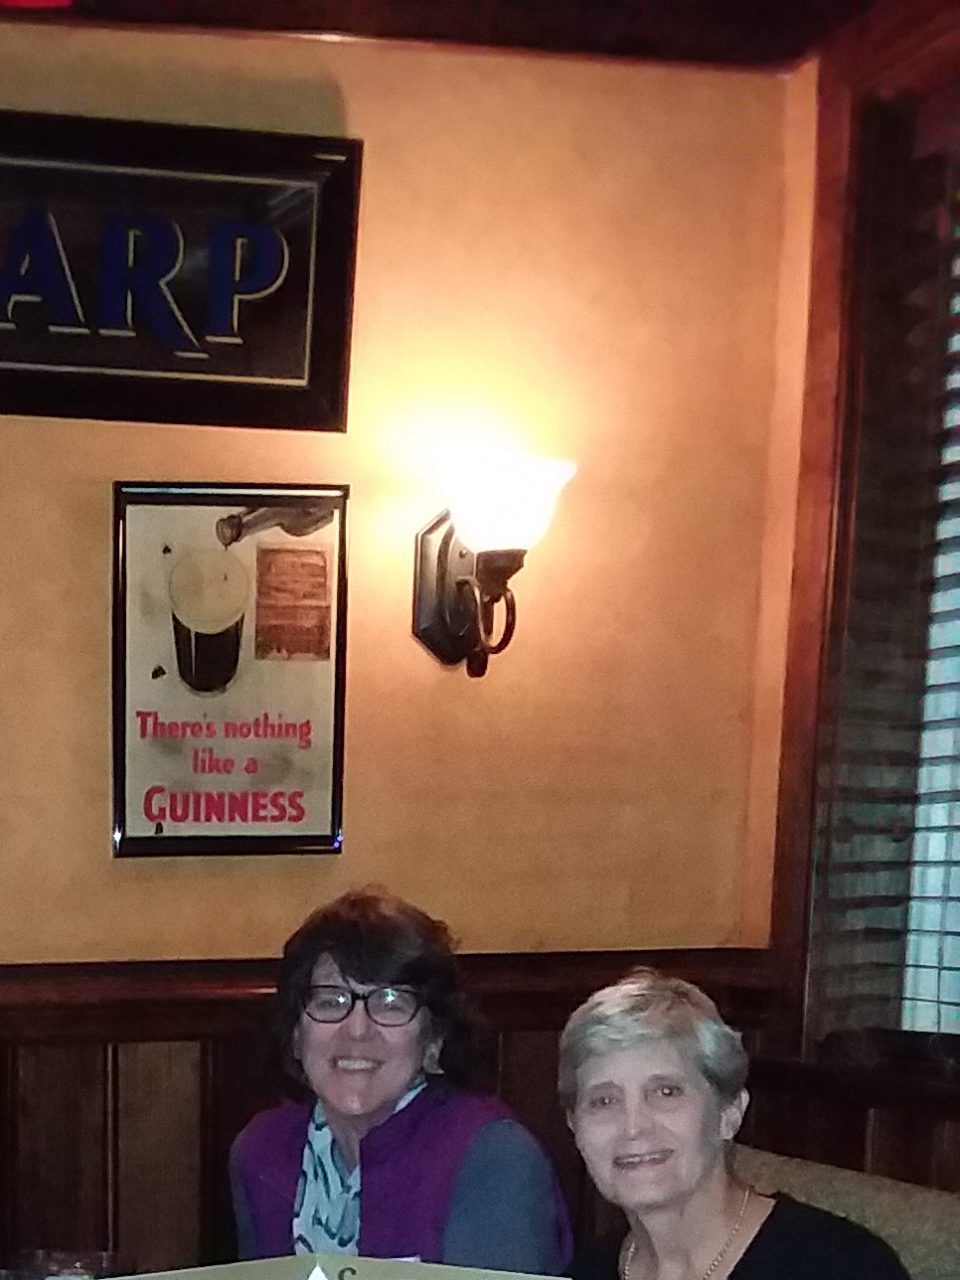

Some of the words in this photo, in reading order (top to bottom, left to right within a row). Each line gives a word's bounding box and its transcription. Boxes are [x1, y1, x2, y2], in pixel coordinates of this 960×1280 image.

[135, 711, 217, 740] There's
[223, 713, 312, 750] nothing
[192, 748, 236, 775] like
[243, 759, 259, 775] a
[143, 785, 306, 825] GUINNESS
